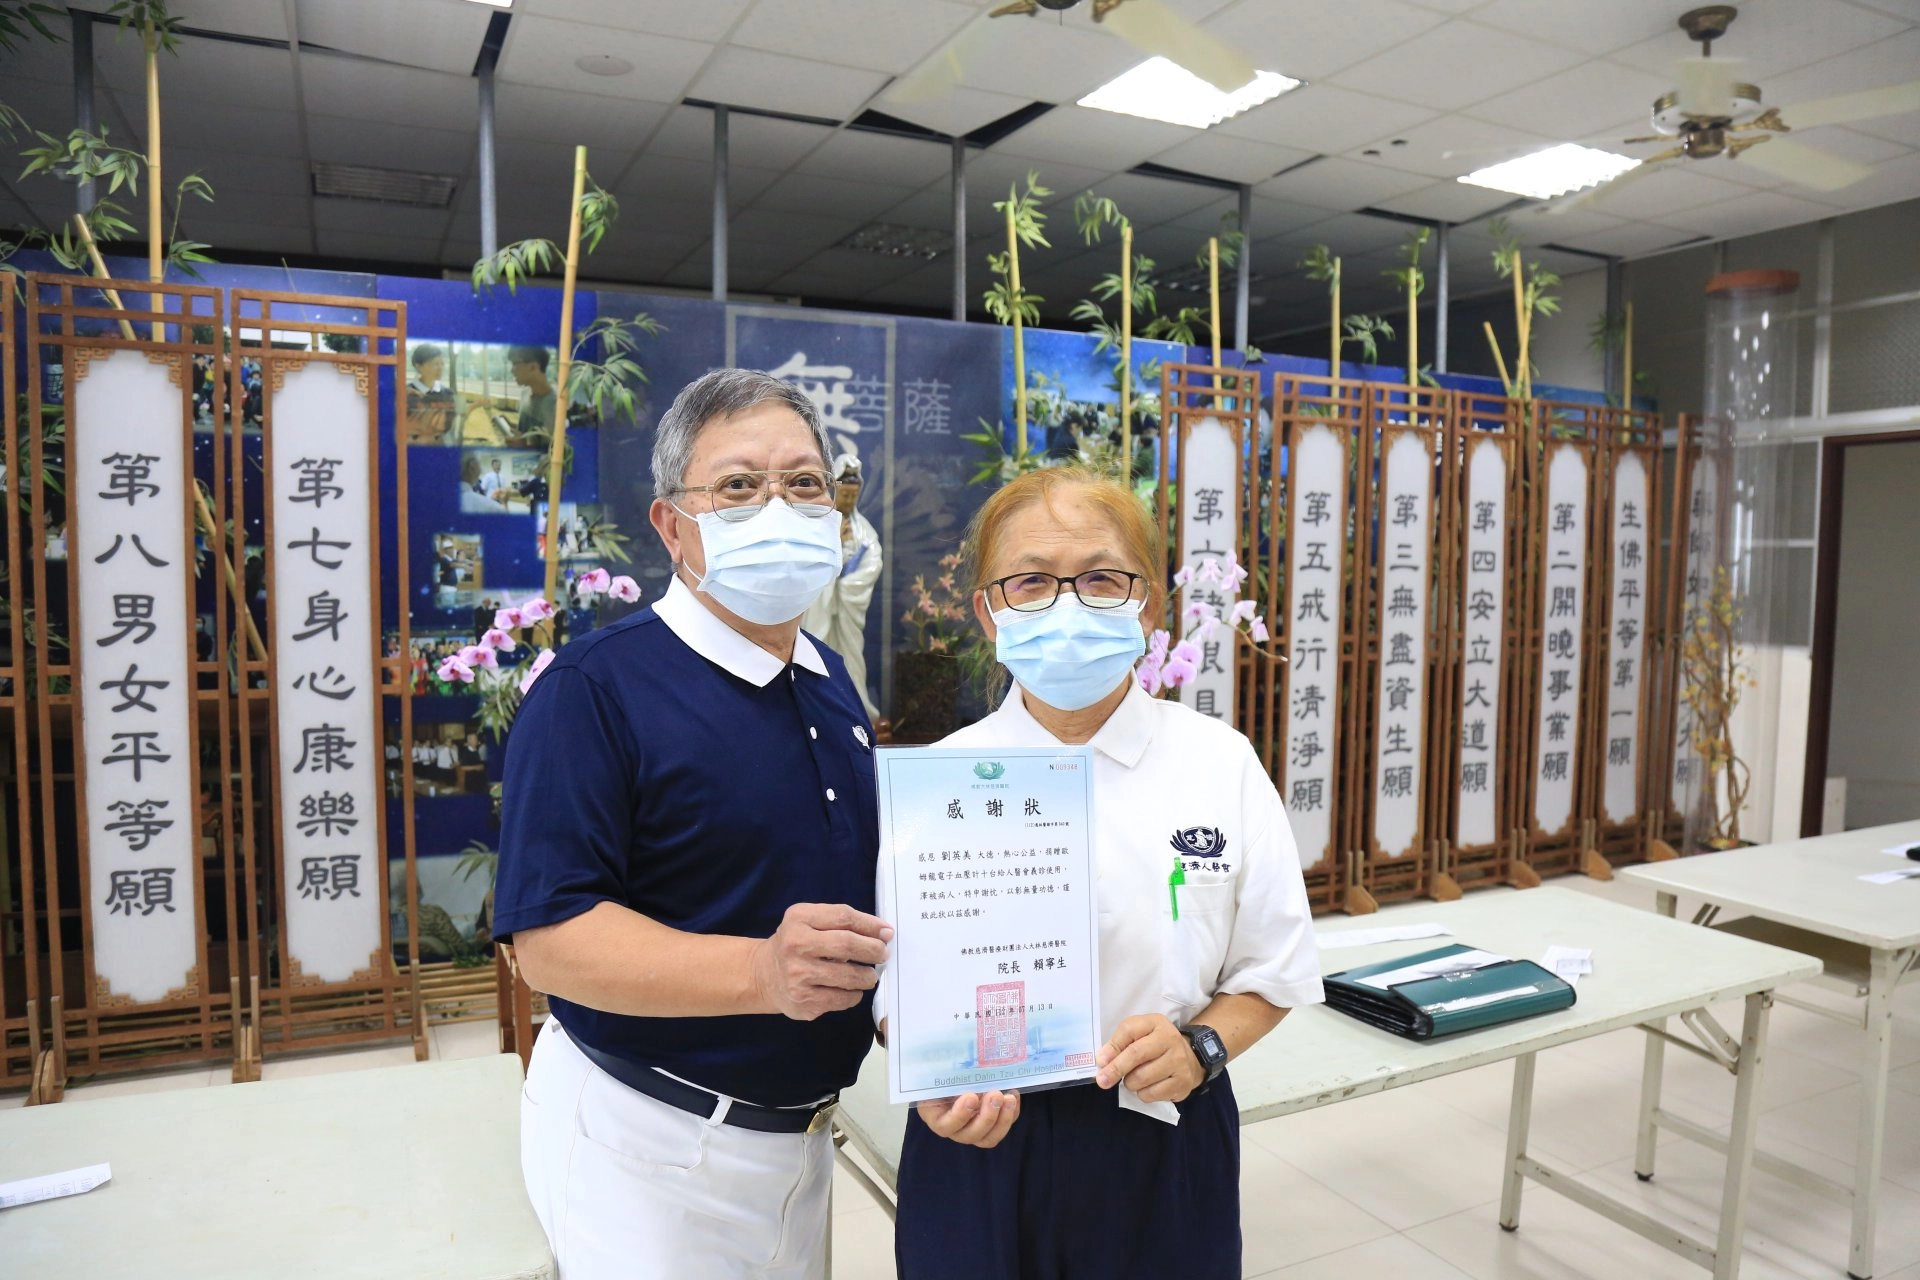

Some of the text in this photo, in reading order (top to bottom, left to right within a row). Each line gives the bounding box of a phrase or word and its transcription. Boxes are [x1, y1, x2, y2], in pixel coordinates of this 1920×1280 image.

[95, 452, 177, 917] 第八男女平等願
[287, 456, 362, 901] 第七身心康樂願
[1290, 491, 1332, 813] 第五戒行清淨願
[1381, 494, 1419, 798] 第三無盡資生願
[1461, 500, 1496, 793] 第四安立大道願
[1541, 502, 1577, 782] 第二開曉事業願
[1607, 501, 1641, 767] 生佛平等第一願
[947, 798, 1042, 819] 感謝狀
[934, 1076, 971, 1086] Buddhist
[975, 1072, 995, 1082] Dalin
[1000, 1069, 1014, 1079] Tzu
[1018, 1065, 1031, 1076] Chi
[1035, 1063, 1065, 1074] Hospital
[997, 960, 1021, 975] 院長
